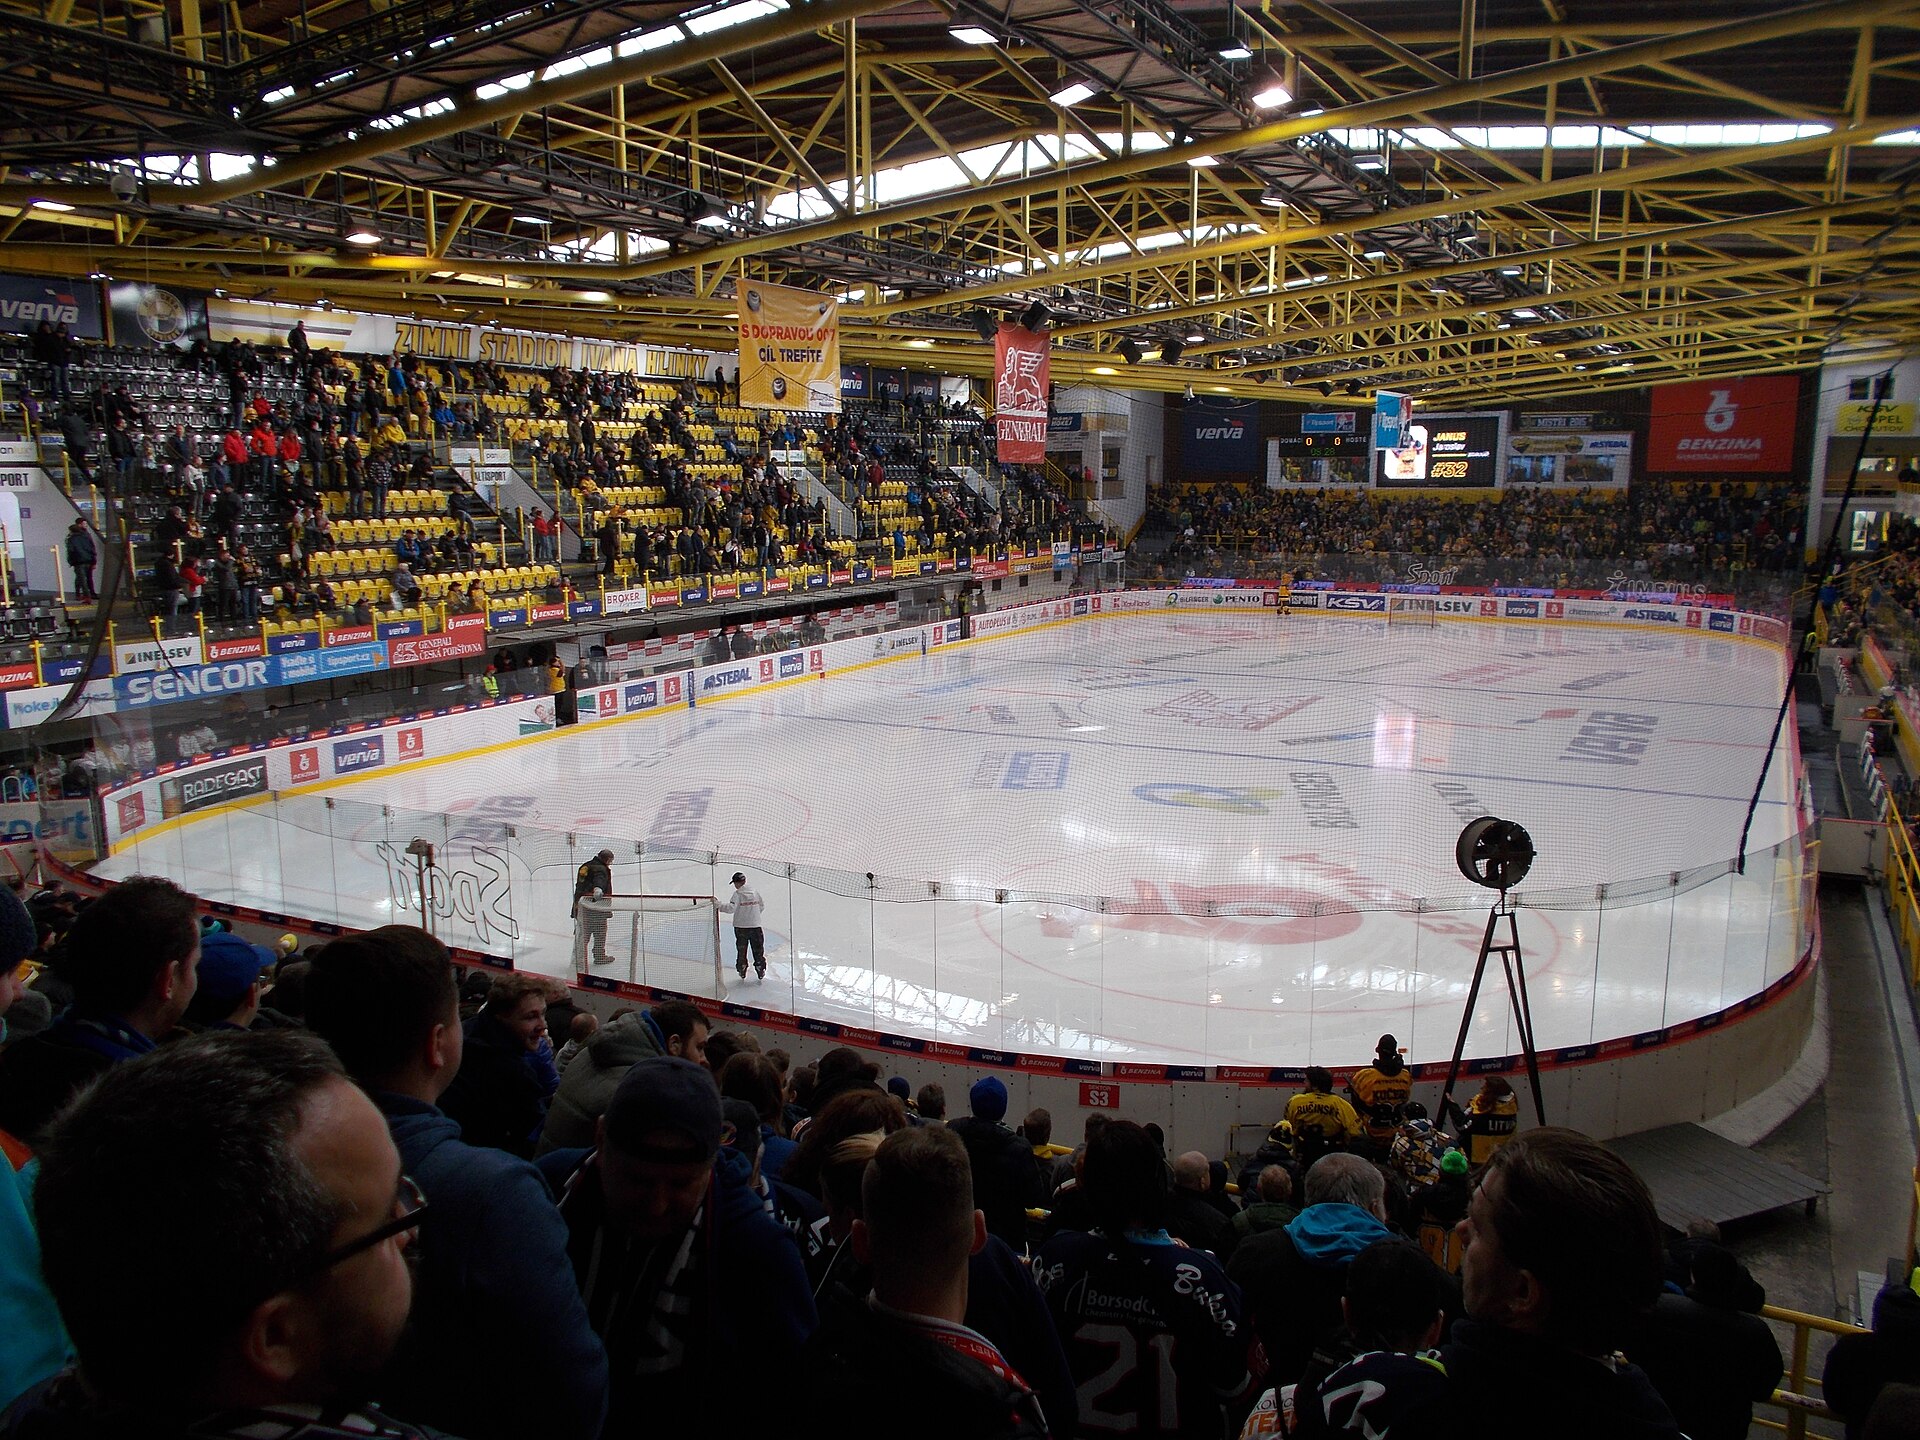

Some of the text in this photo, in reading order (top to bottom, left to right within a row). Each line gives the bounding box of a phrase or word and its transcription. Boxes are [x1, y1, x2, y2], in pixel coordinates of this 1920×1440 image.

[1, 299, 79, 325] verva
[741, 323, 750, 340] S
[752, 323, 814, 342] DOPRAVOU
[395, 321, 710, 380] ZIMNÍ STADION IVANA HLINKY
[758, 344, 823, 364] CÍL TREFÍTE
[840, 378, 862, 390] verva
[878, 382, 900, 393] vrva
[913, 385, 933, 396] verva
[997, 419, 1046, 443] GENERALI
[1195, 426, 1244, 440] verva
[1676, 438, 1762, 450] BENZINA
[606, 592, 640, 605] BROKER
[656, 595, 678, 604] BENZINA
[687, 592, 702, 600] verva
[1225, 595, 1260, 604] PENTO
[576, 605, 593, 614] verva
[1327, 597, 1375, 610] KSV
[1408, 599, 1472, 613] INELSEV
[538, 608, 564, 619] BENZINA
[1507, 606, 1536, 615] verva
[1638, 609, 1679, 622] STEBAL
[455, 617, 485, 628] BENZINA
[498, 613, 518, 623] verva
[336, 630, 372, 643] BENZINA
[388, 626, 411, 636] verva
[281, 638, 306, 649] verva
[418, 636, 452, 650] GENERALI
[137, 646, 192, 663] INELSEV
[220, 643, 261, 656] BENZINA
[419, 641, 483, 660] ČESKÁ POJIŠŤOVNA
[781, 662, 803, 675] verva
[127, 660, 269, 705] SENCOR
[715, 667, 753, 687] STEBAL
[627, 691, 655, 706] verva
[337, 748, 380, 768] verva
[183, 765, 264, 802] RADEGAST
[732, 1007, 750, 1016] verva
[770, 1015, 796, 1026] BENZINA
[809, 1023, 828, 1032] verva
[849, 1030, 877, 1041] BENZINA
[892, 1039, 912, 1048] verva
[936, 1046, 964, 1057] BENZINA
[981, 1053, 1003, 1062] verva
[1028, 1059, 1060, 1069] BENZINA
[1079, 1064, 1101, 1072] verva
[1127, 1068, 1161, 1076] BENZINA
[1181, 1069, 1203, 1078] verva
[1231, 1071, 1265, 1079] BENZINA
[1089, 1090, 1109, 1107] S3
[1074, 1322, 1180, 1431] 21
